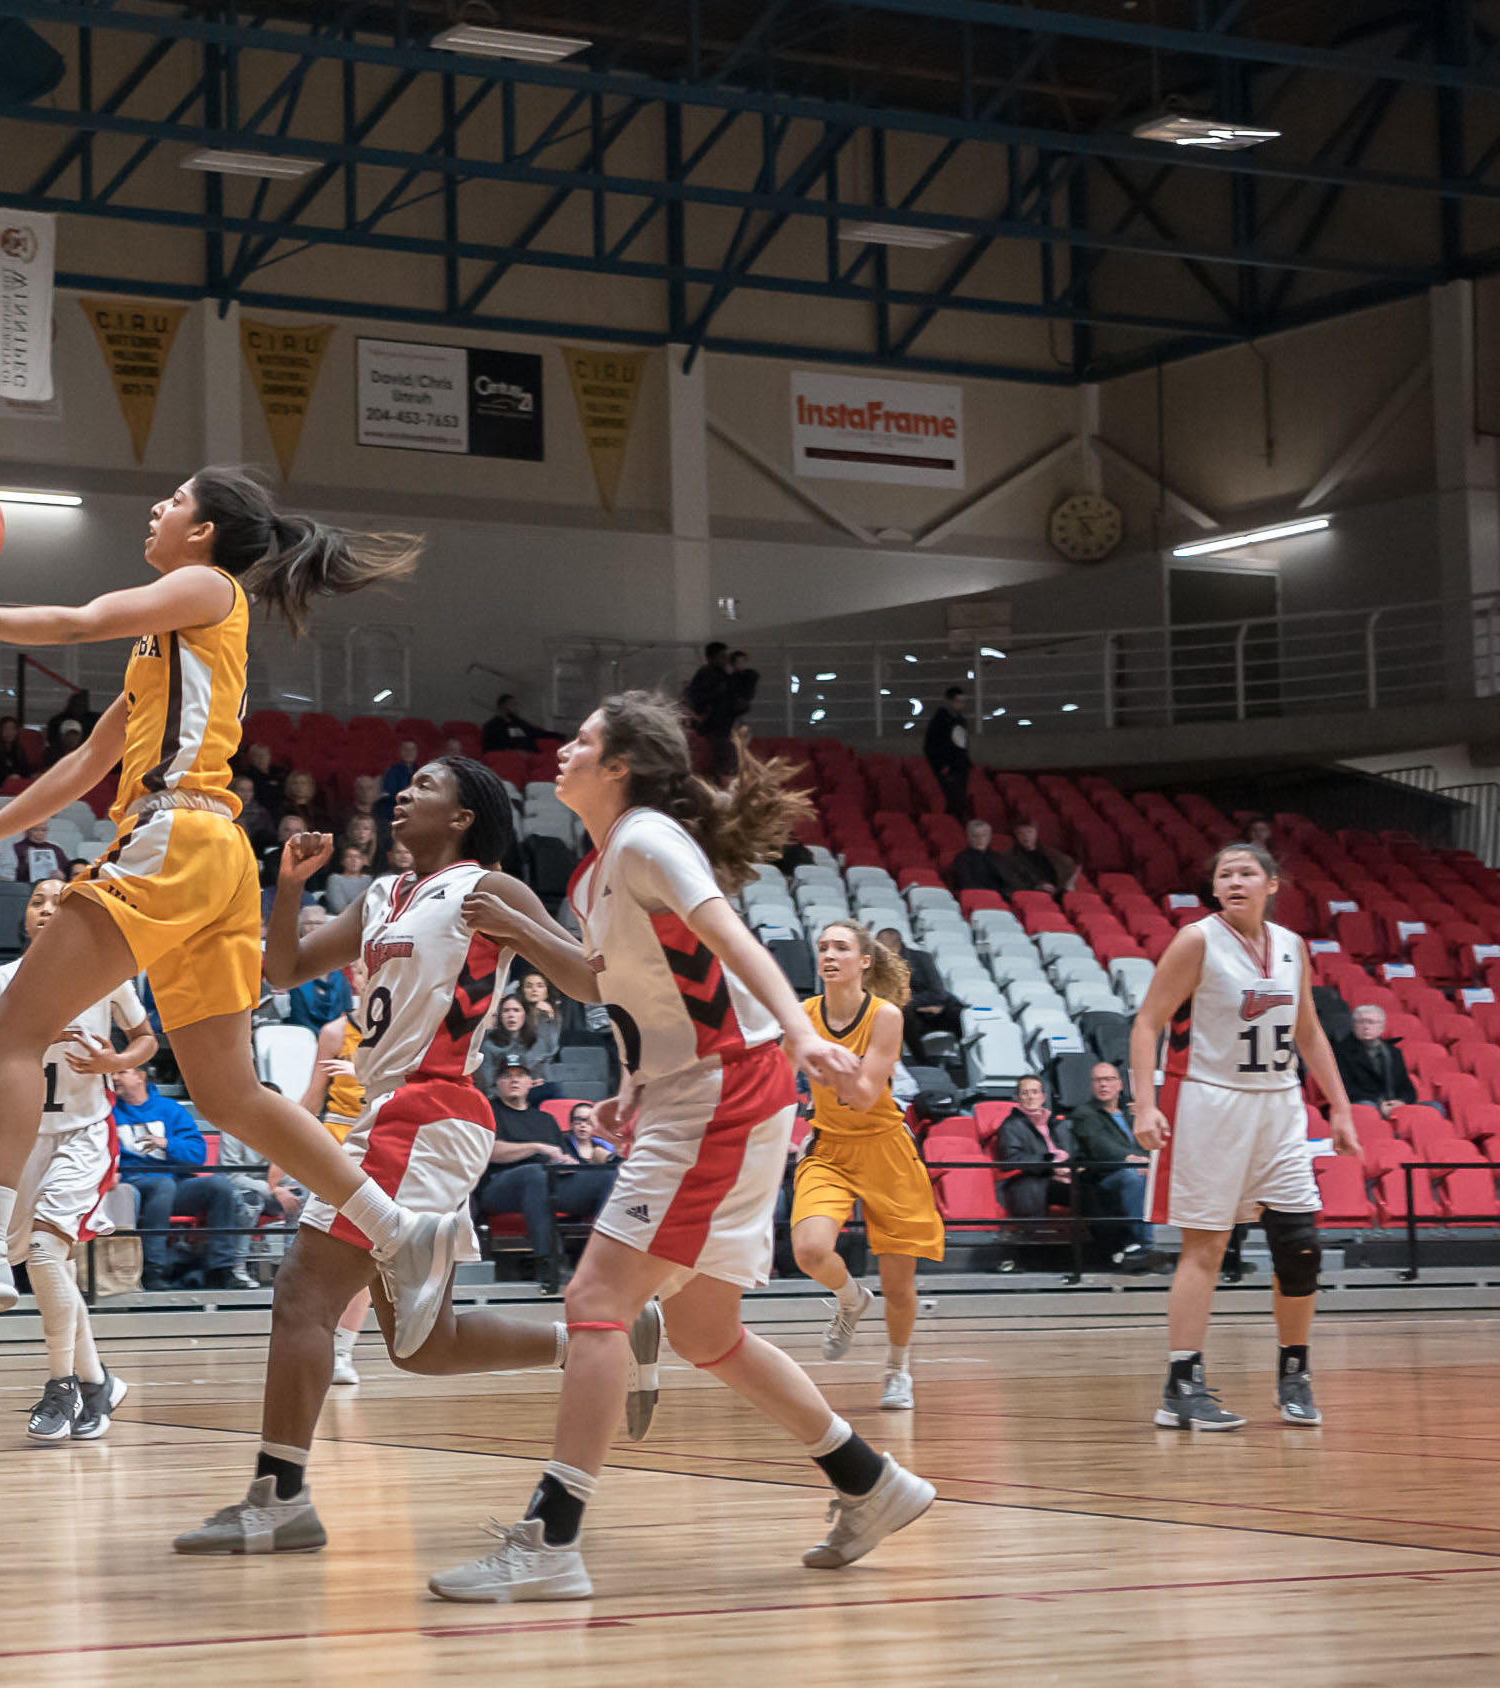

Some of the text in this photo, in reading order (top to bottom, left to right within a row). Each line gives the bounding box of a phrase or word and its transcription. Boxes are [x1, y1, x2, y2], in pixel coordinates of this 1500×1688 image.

[474, 375, 524, 400] Century
[796, 395, 957, 440] InstaFrame
[1237, 1024, 1293, 1072] 15
